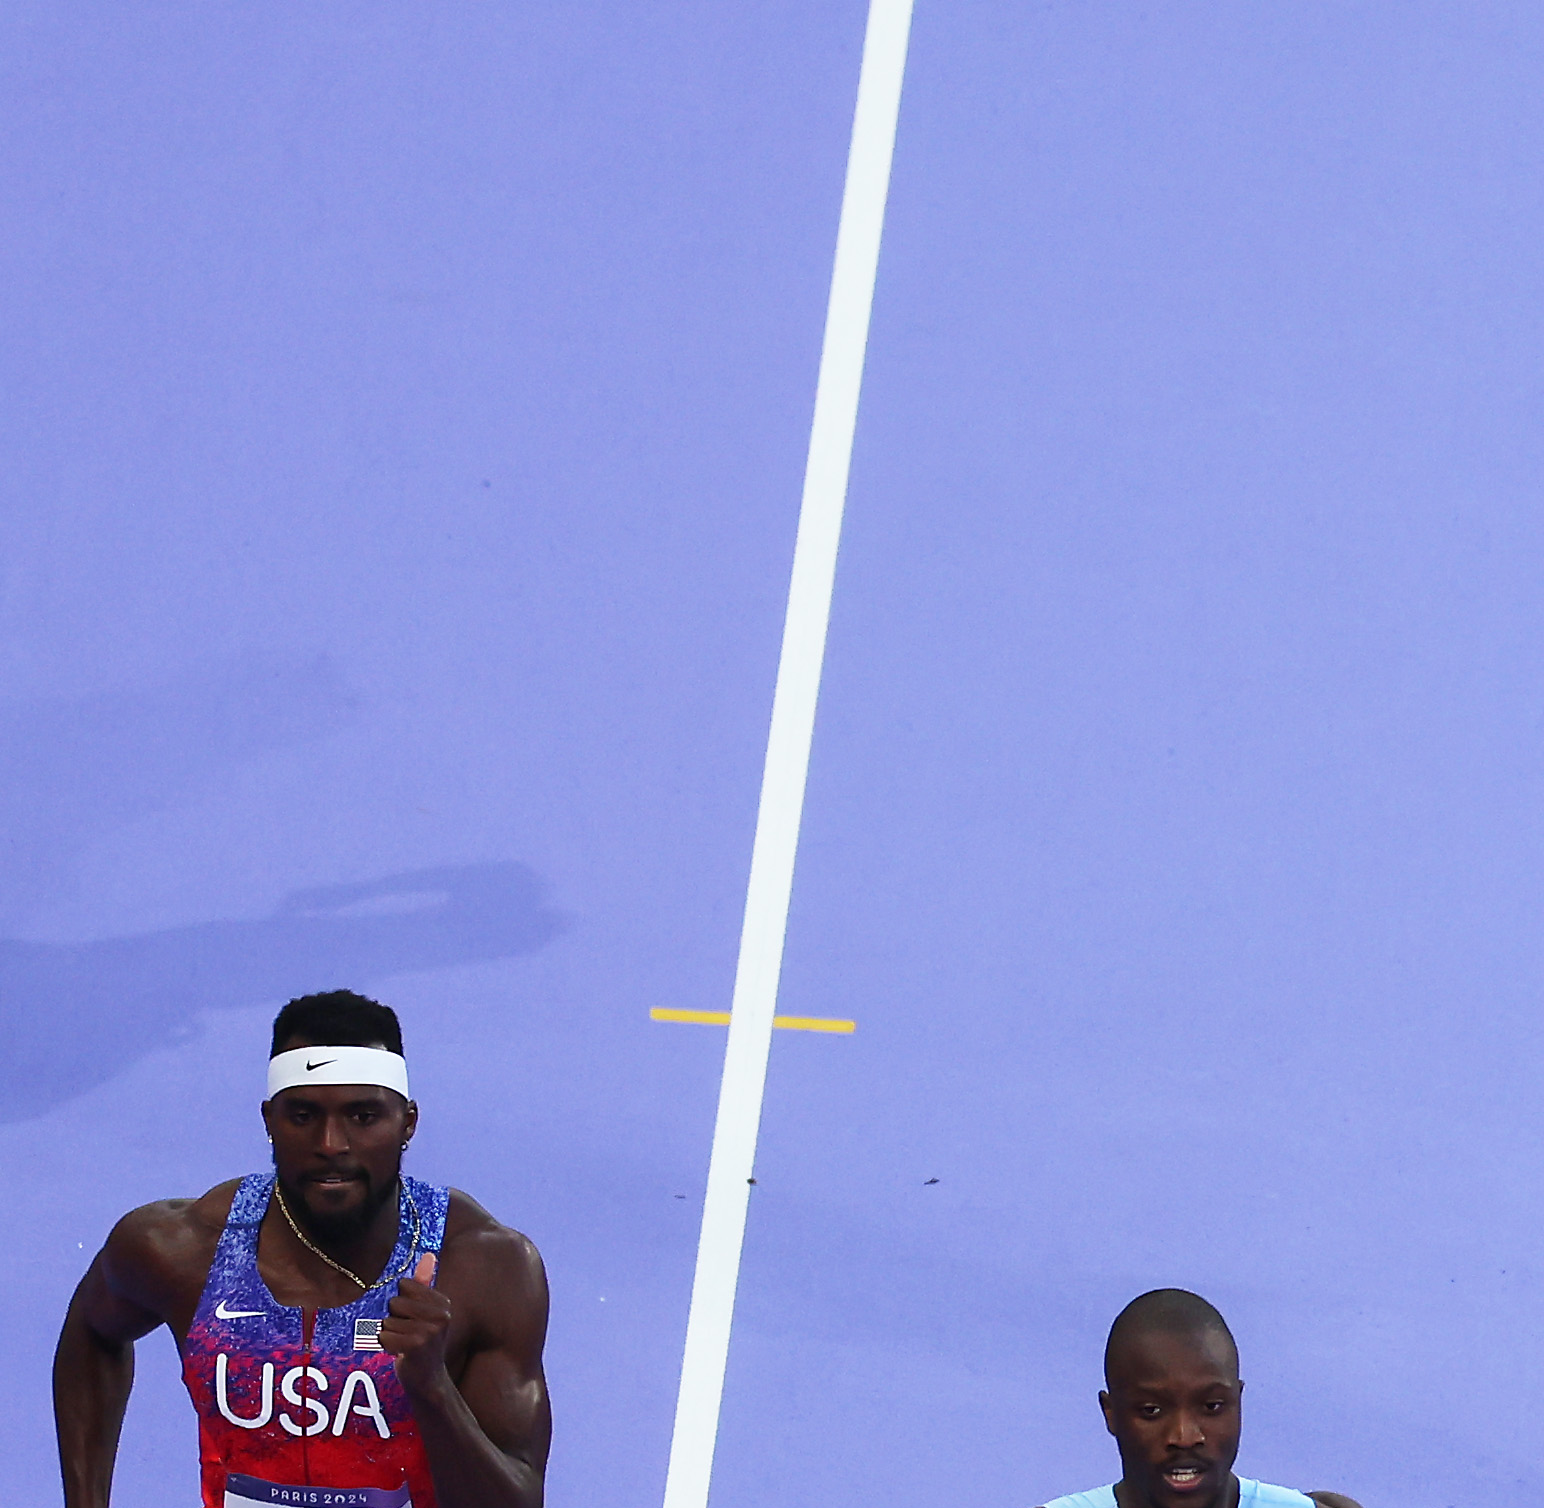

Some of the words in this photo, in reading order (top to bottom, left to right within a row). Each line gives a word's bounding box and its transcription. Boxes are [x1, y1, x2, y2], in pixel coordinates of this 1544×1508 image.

[216, 1353, 391, 1439] USA
[271, 1487, 317, 1503] PARIS
[323, 1493, 367, 1504] 2024
